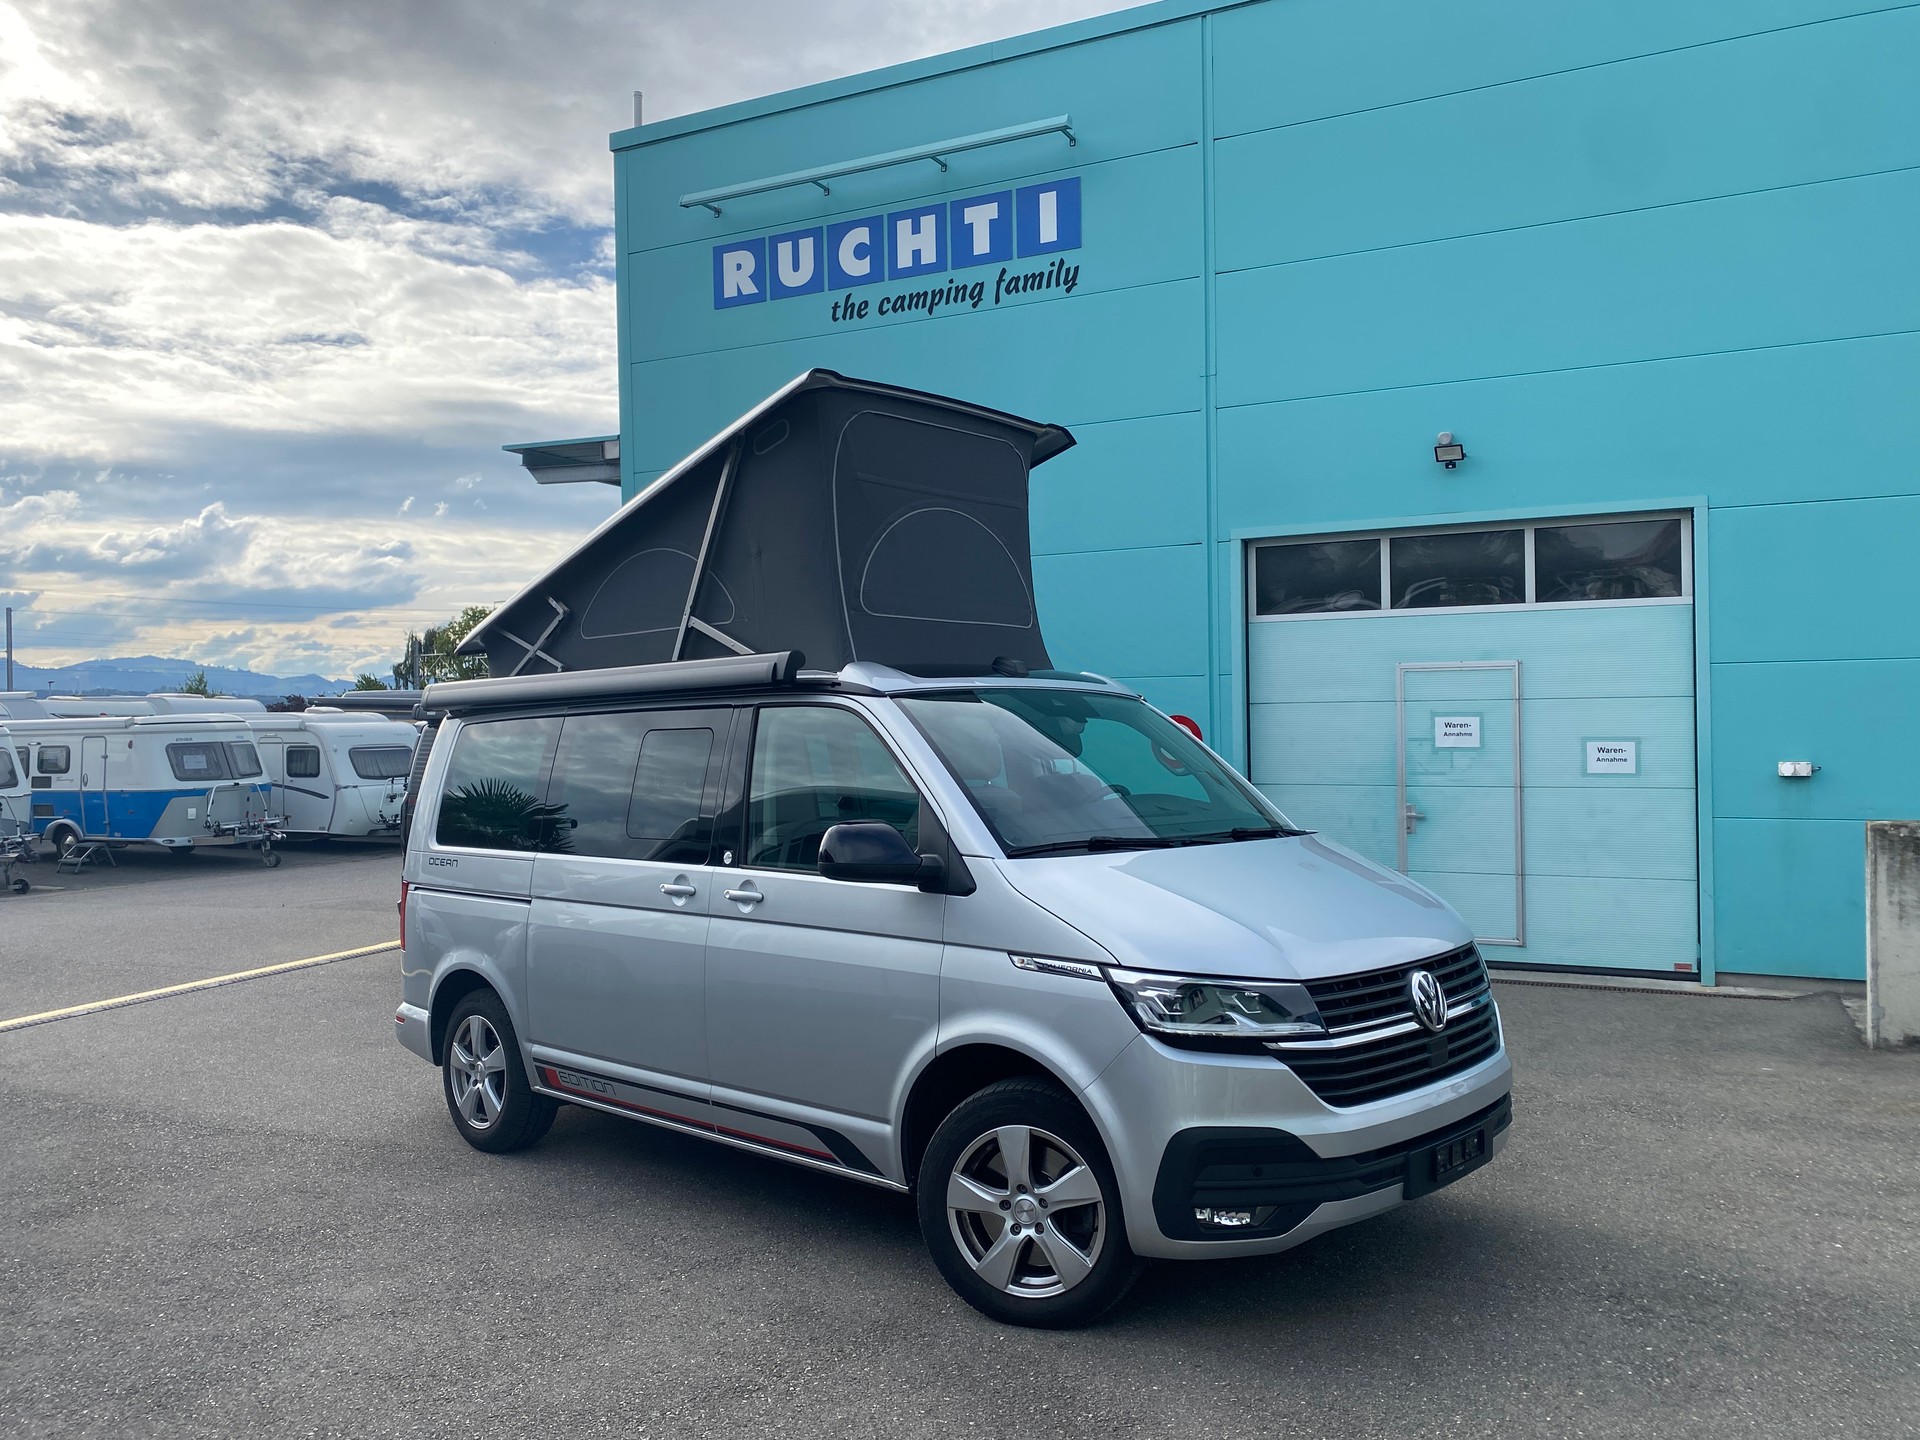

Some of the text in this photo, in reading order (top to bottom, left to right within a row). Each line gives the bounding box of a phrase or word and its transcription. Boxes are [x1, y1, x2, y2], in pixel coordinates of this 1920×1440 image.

[722, 190, 1059, 300] RUCHTI
[831, 257, 1081, 323] the camping family
[1443, 721, 1472, 729] Waren-
[1597, 746, 1627, 754] Waren-
[428, 857, 459, 868] OCEAN
[558, 1070, 617, 1097] EDITION
